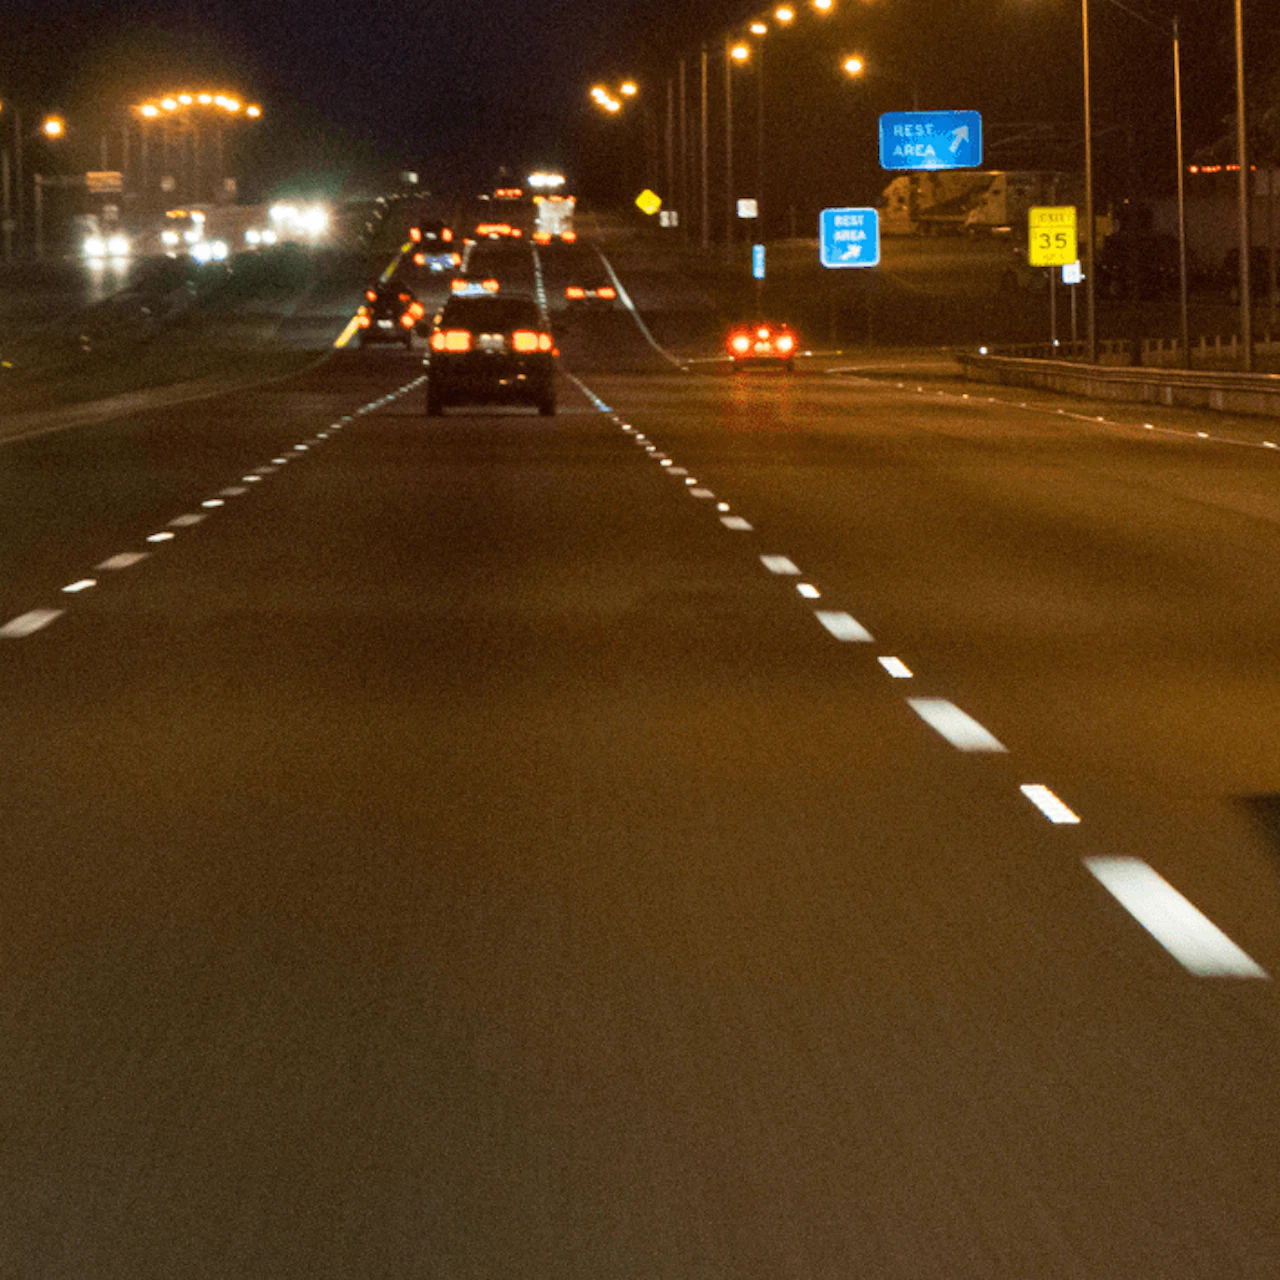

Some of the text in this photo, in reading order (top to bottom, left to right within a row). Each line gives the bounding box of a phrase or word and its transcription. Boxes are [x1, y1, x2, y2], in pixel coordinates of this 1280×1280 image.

[893, 123, 934, 136] REST
[892, 144, 936, 157] AREA
[1039, 232, 1067, 249] 35
